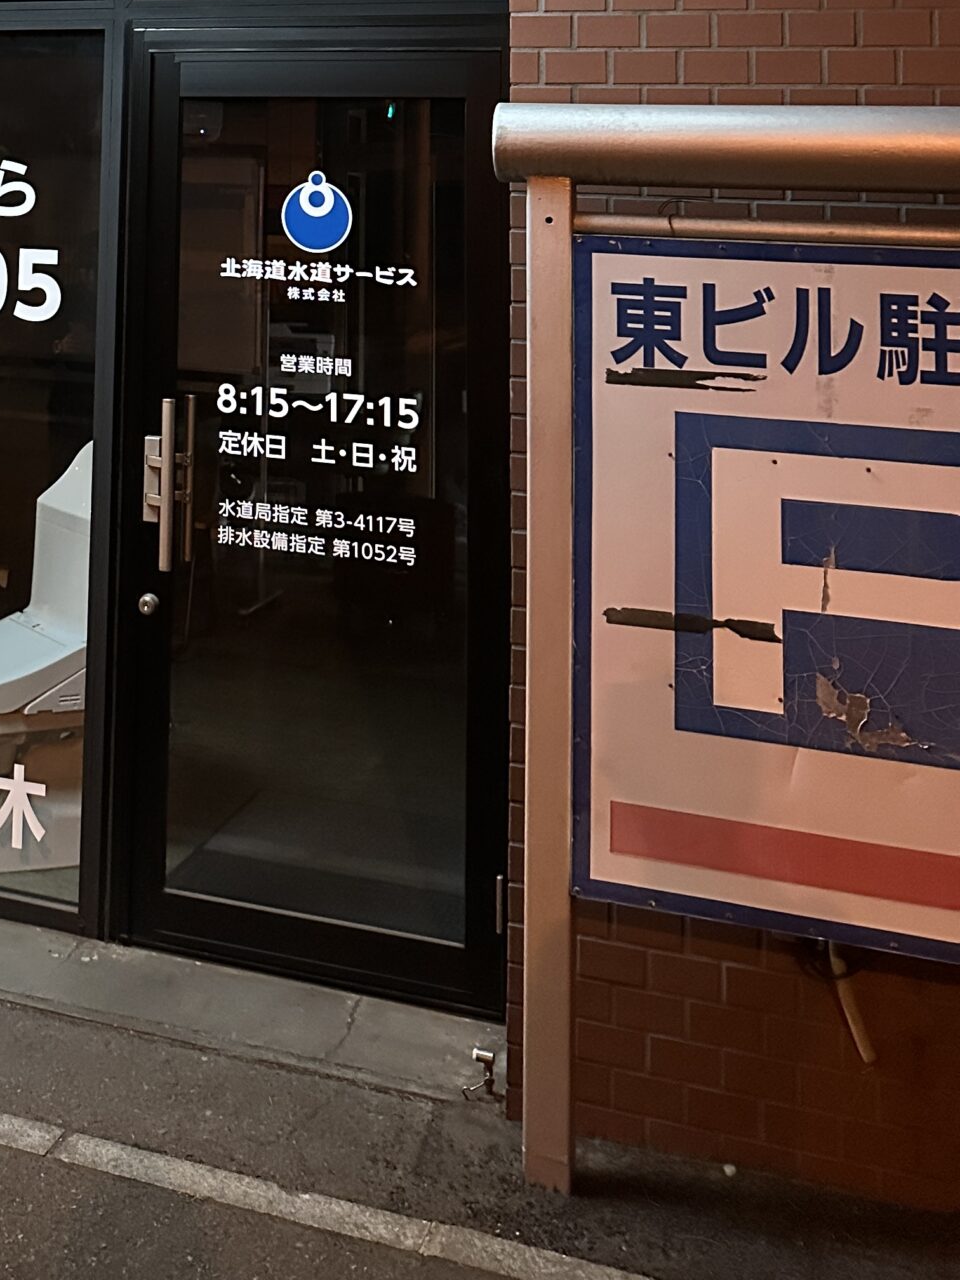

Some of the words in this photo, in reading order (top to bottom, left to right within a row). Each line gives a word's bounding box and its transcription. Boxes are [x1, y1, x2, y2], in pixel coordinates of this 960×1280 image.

[219, 257, 418, 288] 北海道水道サービス
[286, 286, 346, 303] 株式会社
[279, 353, 352, 377] 営業時間
[218, 429, 286, 460] 定休日
[311, 437, 417, 473] 土・日・祝
[218, 498, 309, 527] 水道局指定
[315, 508, 416, 537] 第3-4117号
[217, 524, 326, 557] 排水設備指定
[332, 536, 417, 567] 第1052号
